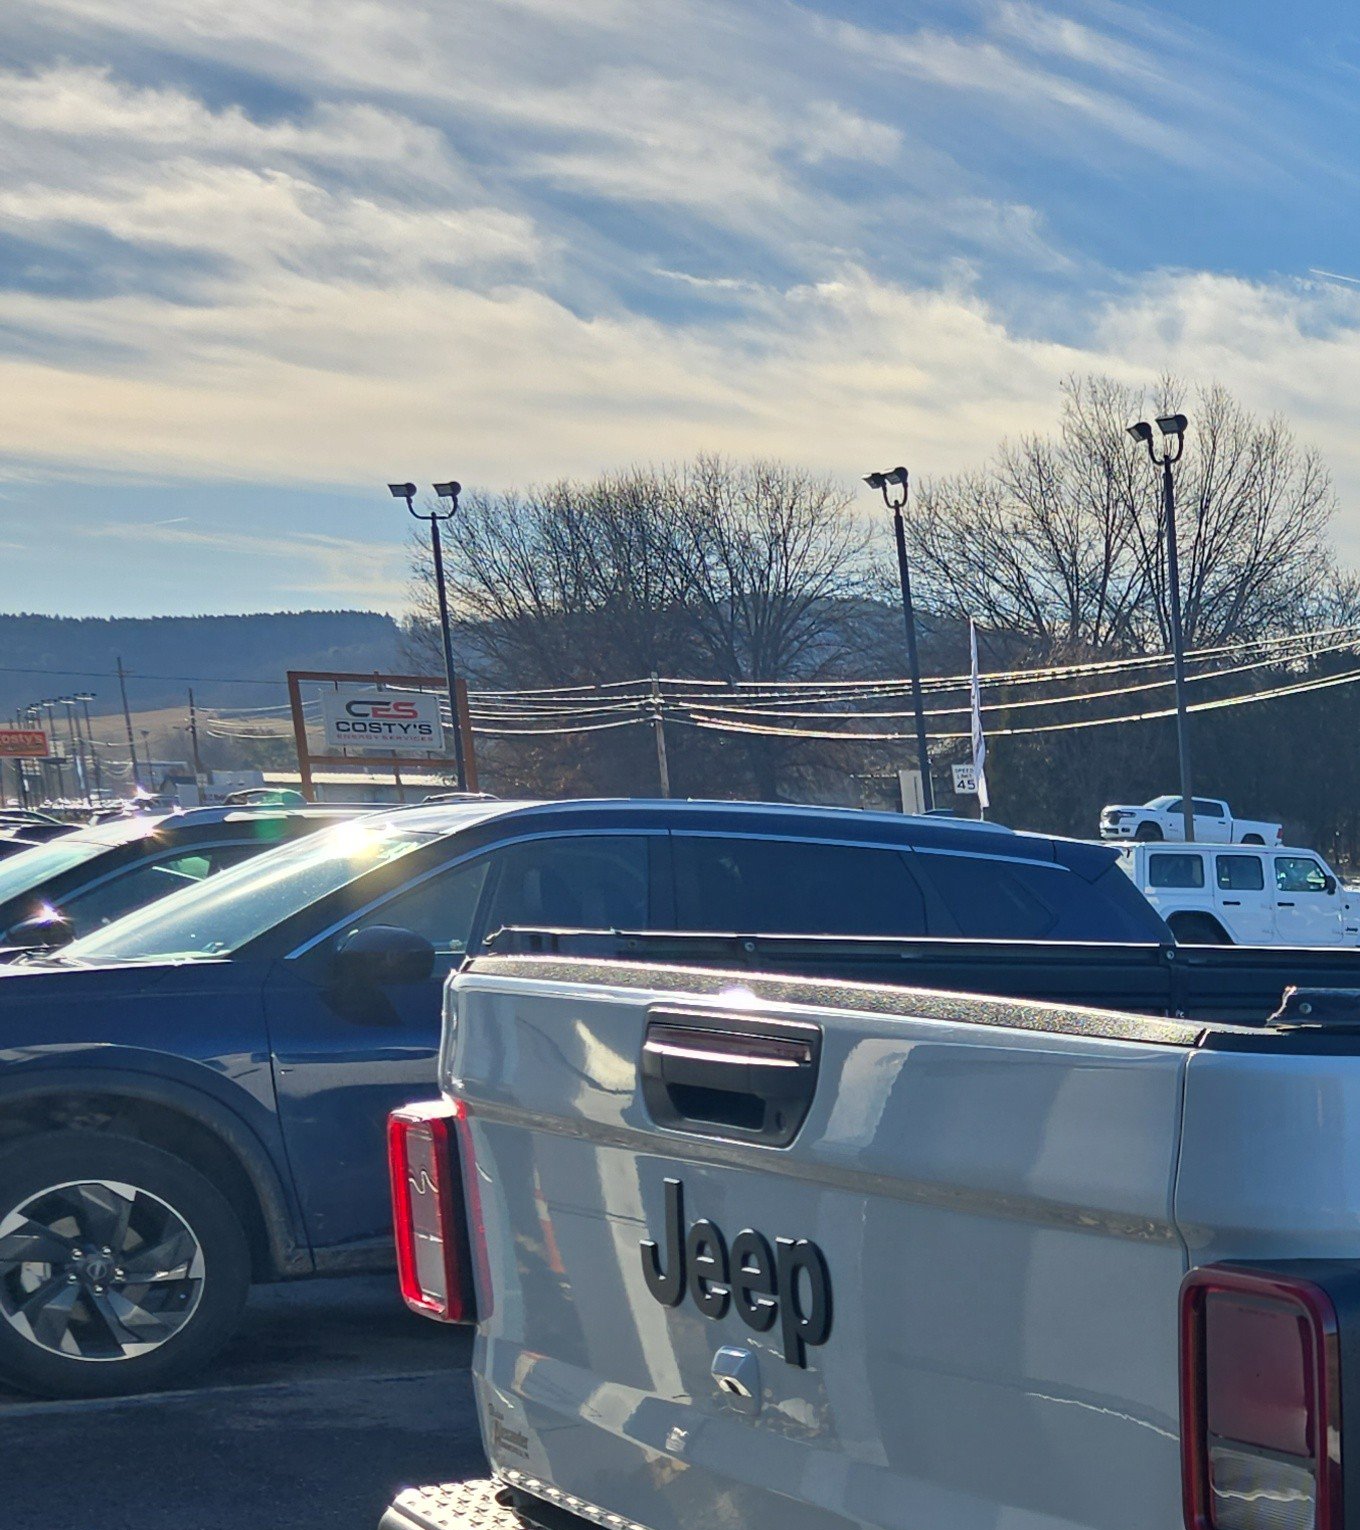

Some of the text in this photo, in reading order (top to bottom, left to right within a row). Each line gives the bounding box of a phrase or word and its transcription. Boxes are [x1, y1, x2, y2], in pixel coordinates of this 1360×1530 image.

[345, 700, 418, 719] CES
[335, 721, 433, 735] COSTY'S
[957, 780, 976, 790] 45
[639, 1177, 834, 1369] Jeep
